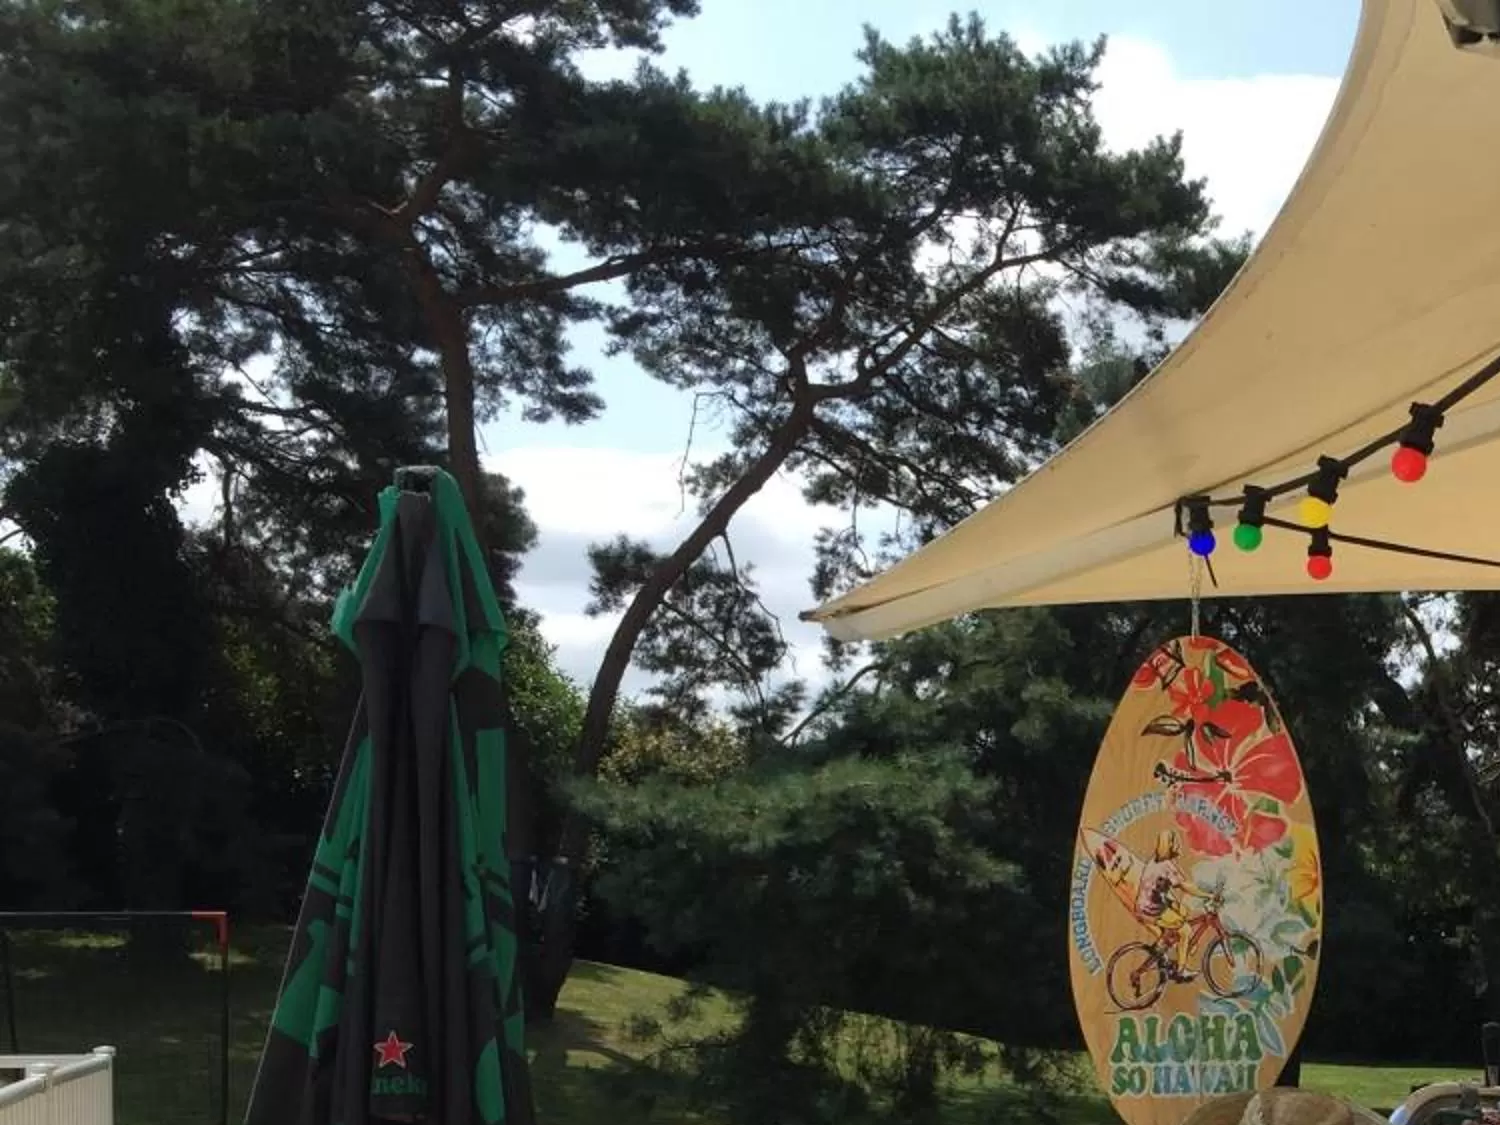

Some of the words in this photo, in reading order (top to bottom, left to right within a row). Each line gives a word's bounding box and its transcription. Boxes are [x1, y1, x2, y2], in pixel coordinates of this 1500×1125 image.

[1070, 857, 1103, 976] LONGBOARD
[1109, 1013, 1264, 1064] ALOHA
[1109, 1064, 1150, 1097] SO
[1151, 1063, 1260, 1096] HAWAII
